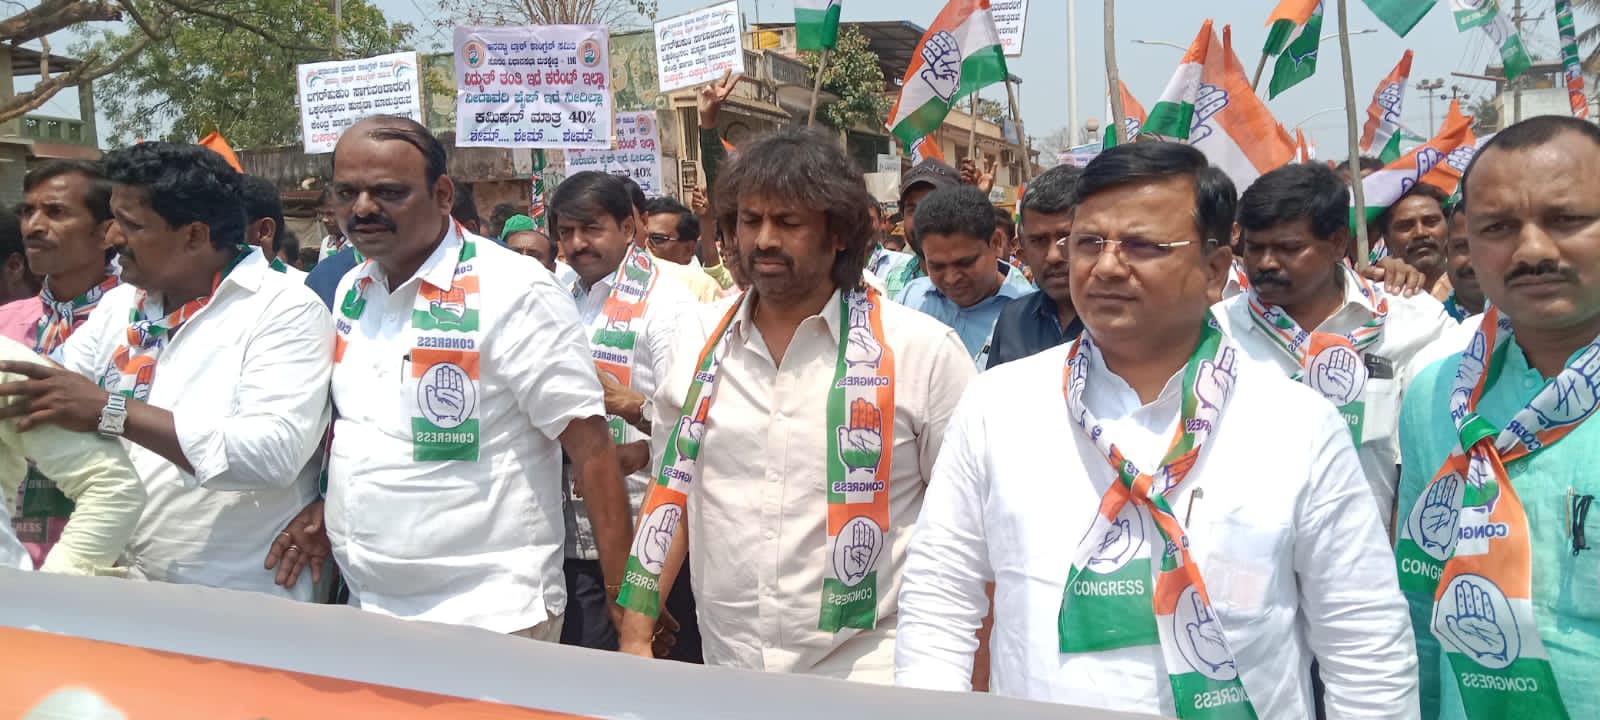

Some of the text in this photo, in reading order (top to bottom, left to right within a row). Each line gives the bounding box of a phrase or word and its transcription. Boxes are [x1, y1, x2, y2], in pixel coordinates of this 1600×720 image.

[475, 110, 596, 128] ಕಮಿಷನ್ ಮಾತ್ರ 40%
[1074, 579, 1144, 596] CONGRESS
